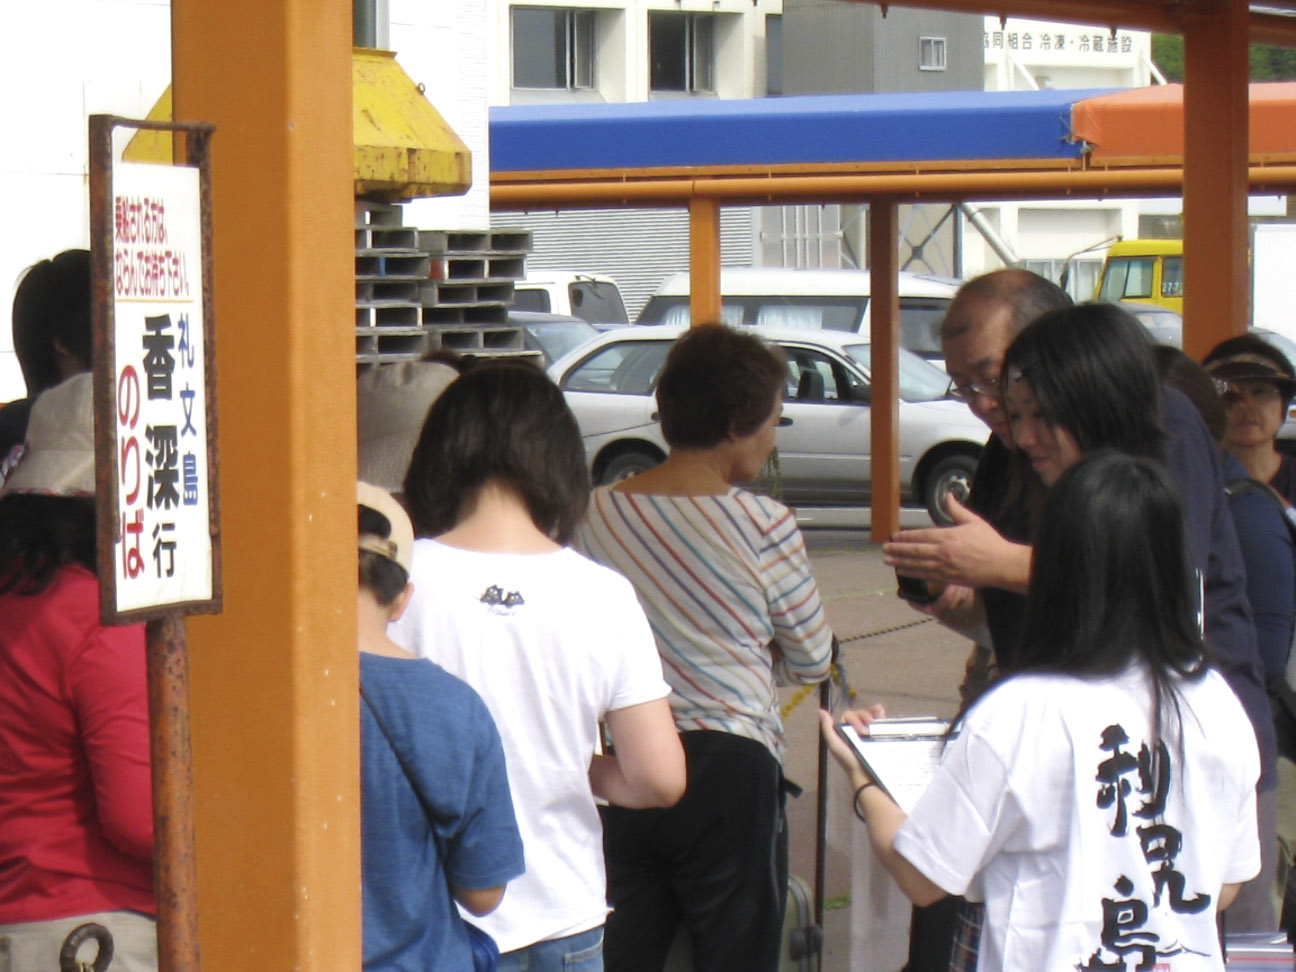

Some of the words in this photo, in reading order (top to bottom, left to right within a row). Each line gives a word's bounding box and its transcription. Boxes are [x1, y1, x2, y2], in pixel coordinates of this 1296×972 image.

[117, 364, 145, 580] のりば
[142, 313, 180, 579] 香深行
[178, 312, 198, 506] 礼文島
